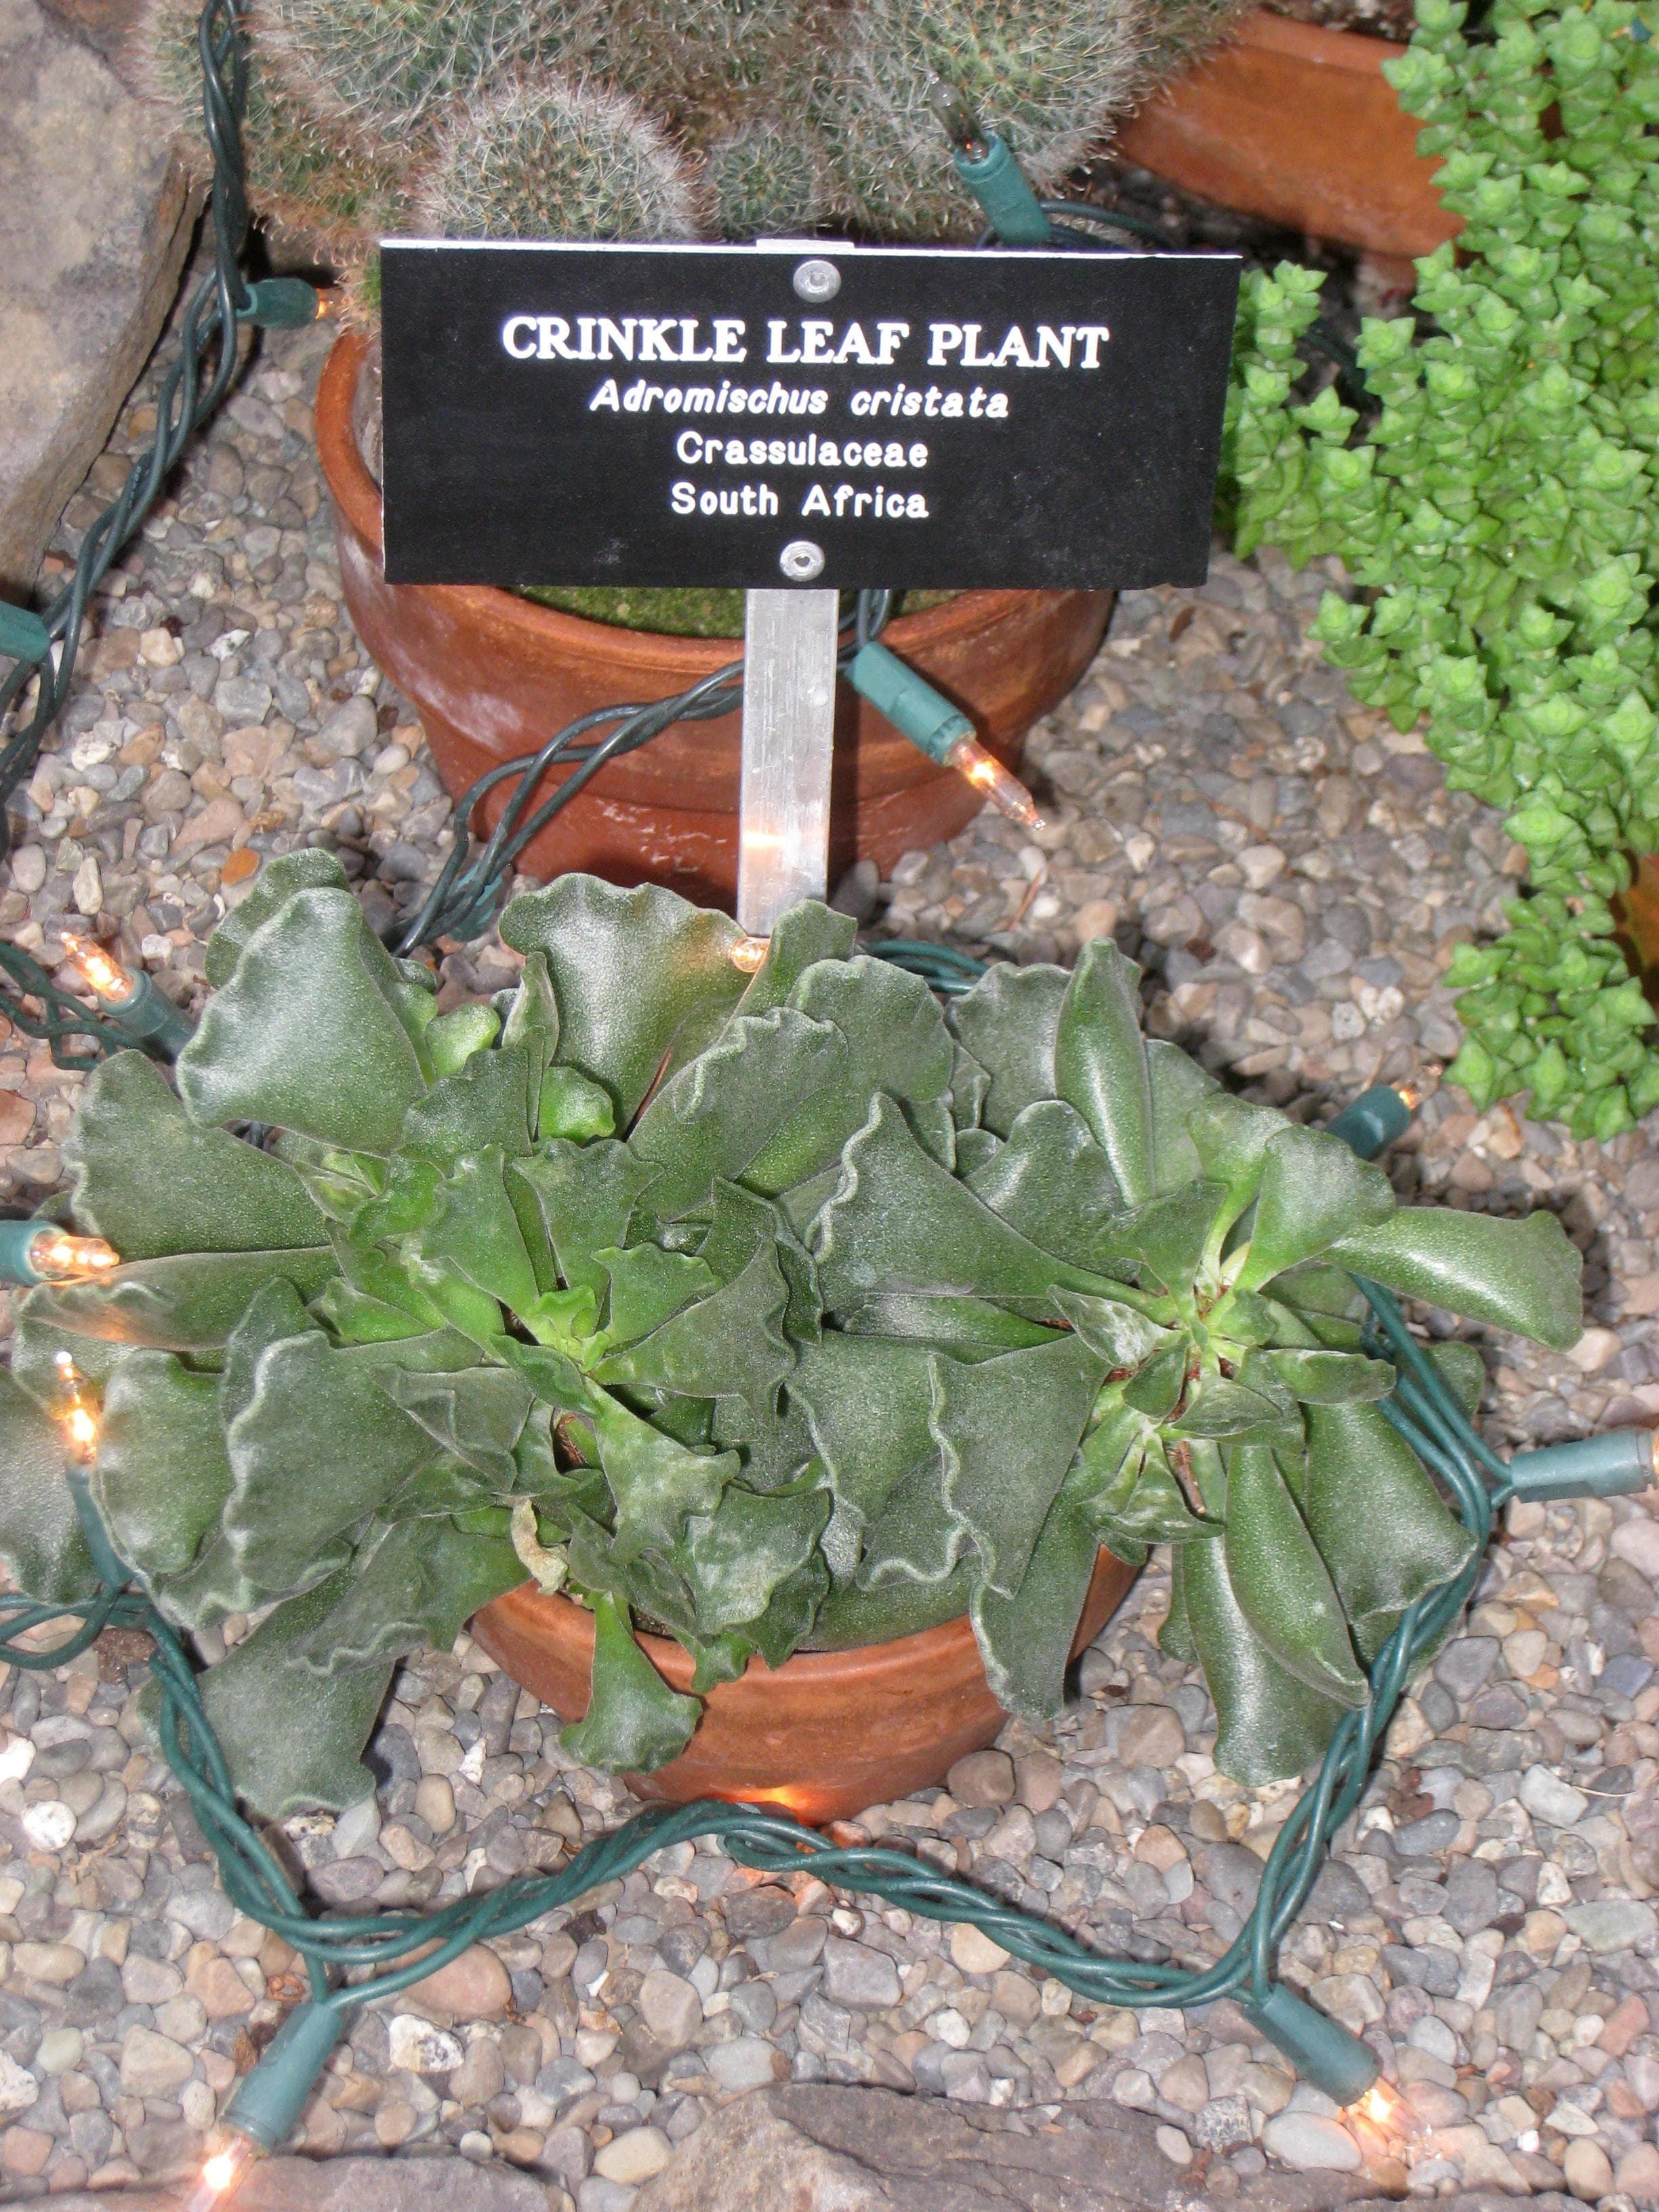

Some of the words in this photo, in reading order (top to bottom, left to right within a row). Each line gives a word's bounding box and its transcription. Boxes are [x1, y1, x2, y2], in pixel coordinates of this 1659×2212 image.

[502, 315, 747, 365] CRINKLE
[766, 320, 910, 365] LEAF
[927, 323, 1110, 369] PLANT
[590, 378, 829, 415] Adromischus
[850, 383, 1009, 419] cristata
[676, 430, 928, 468] Crassulaceae
[671, 481, 779, 516] South
[801, 484, 930, 519] Africa
